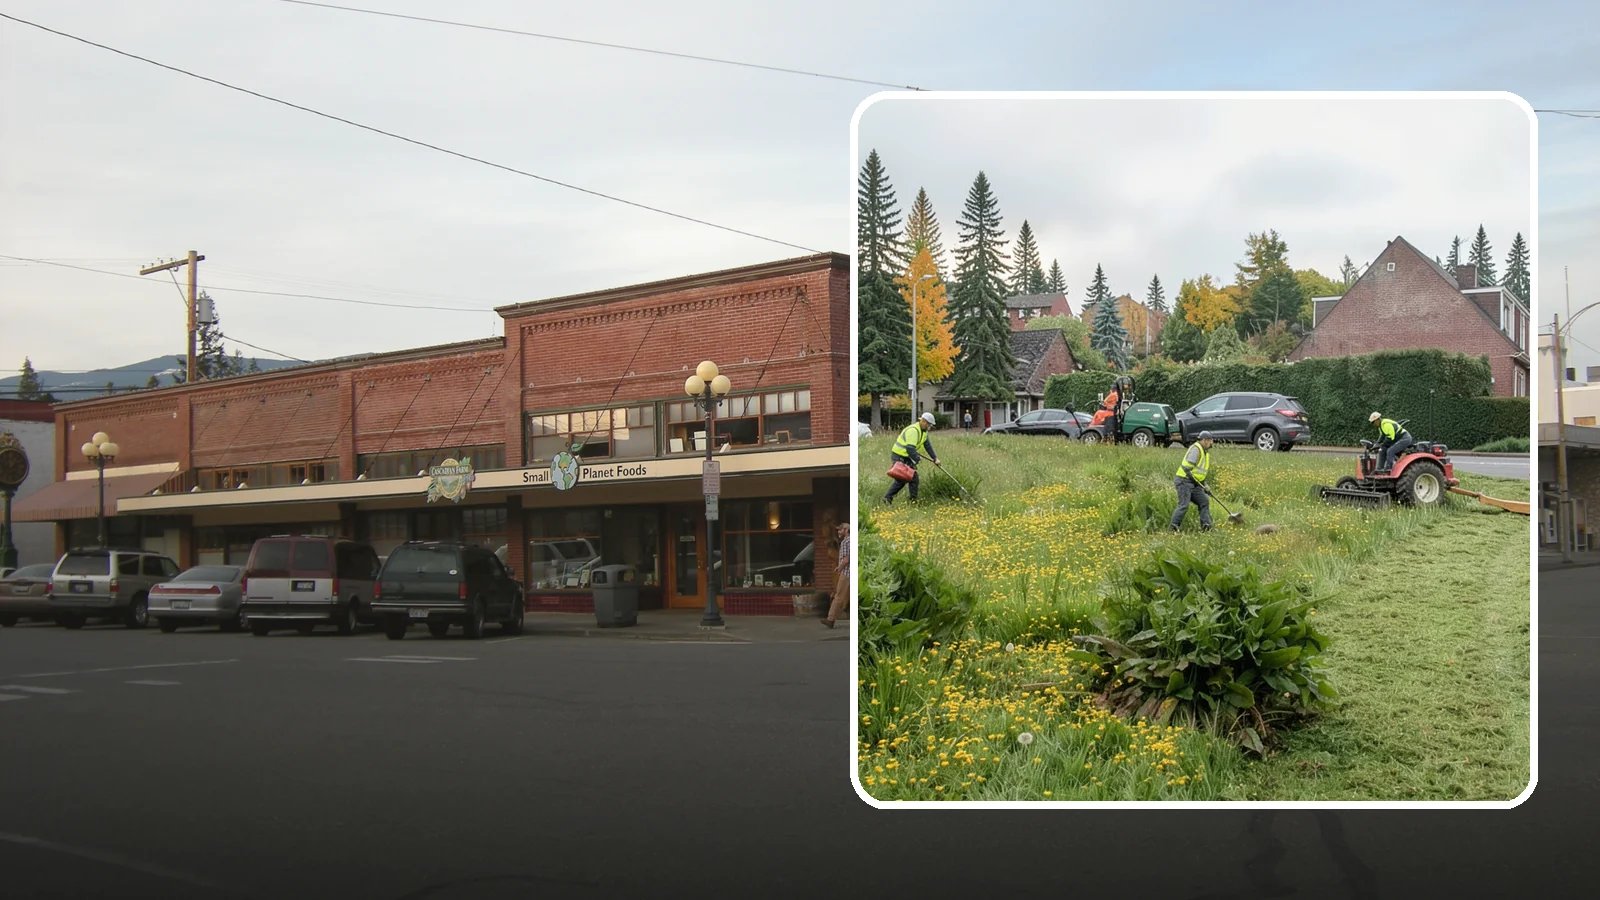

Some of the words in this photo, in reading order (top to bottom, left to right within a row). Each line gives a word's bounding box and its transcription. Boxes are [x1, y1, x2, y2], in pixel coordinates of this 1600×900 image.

[431, 466, 456, 476] CASCADIAN
[523, 471, 549, 483] Small
[583, 467, 614, 479] Planet
[617, 464, 647, 476] Foods
